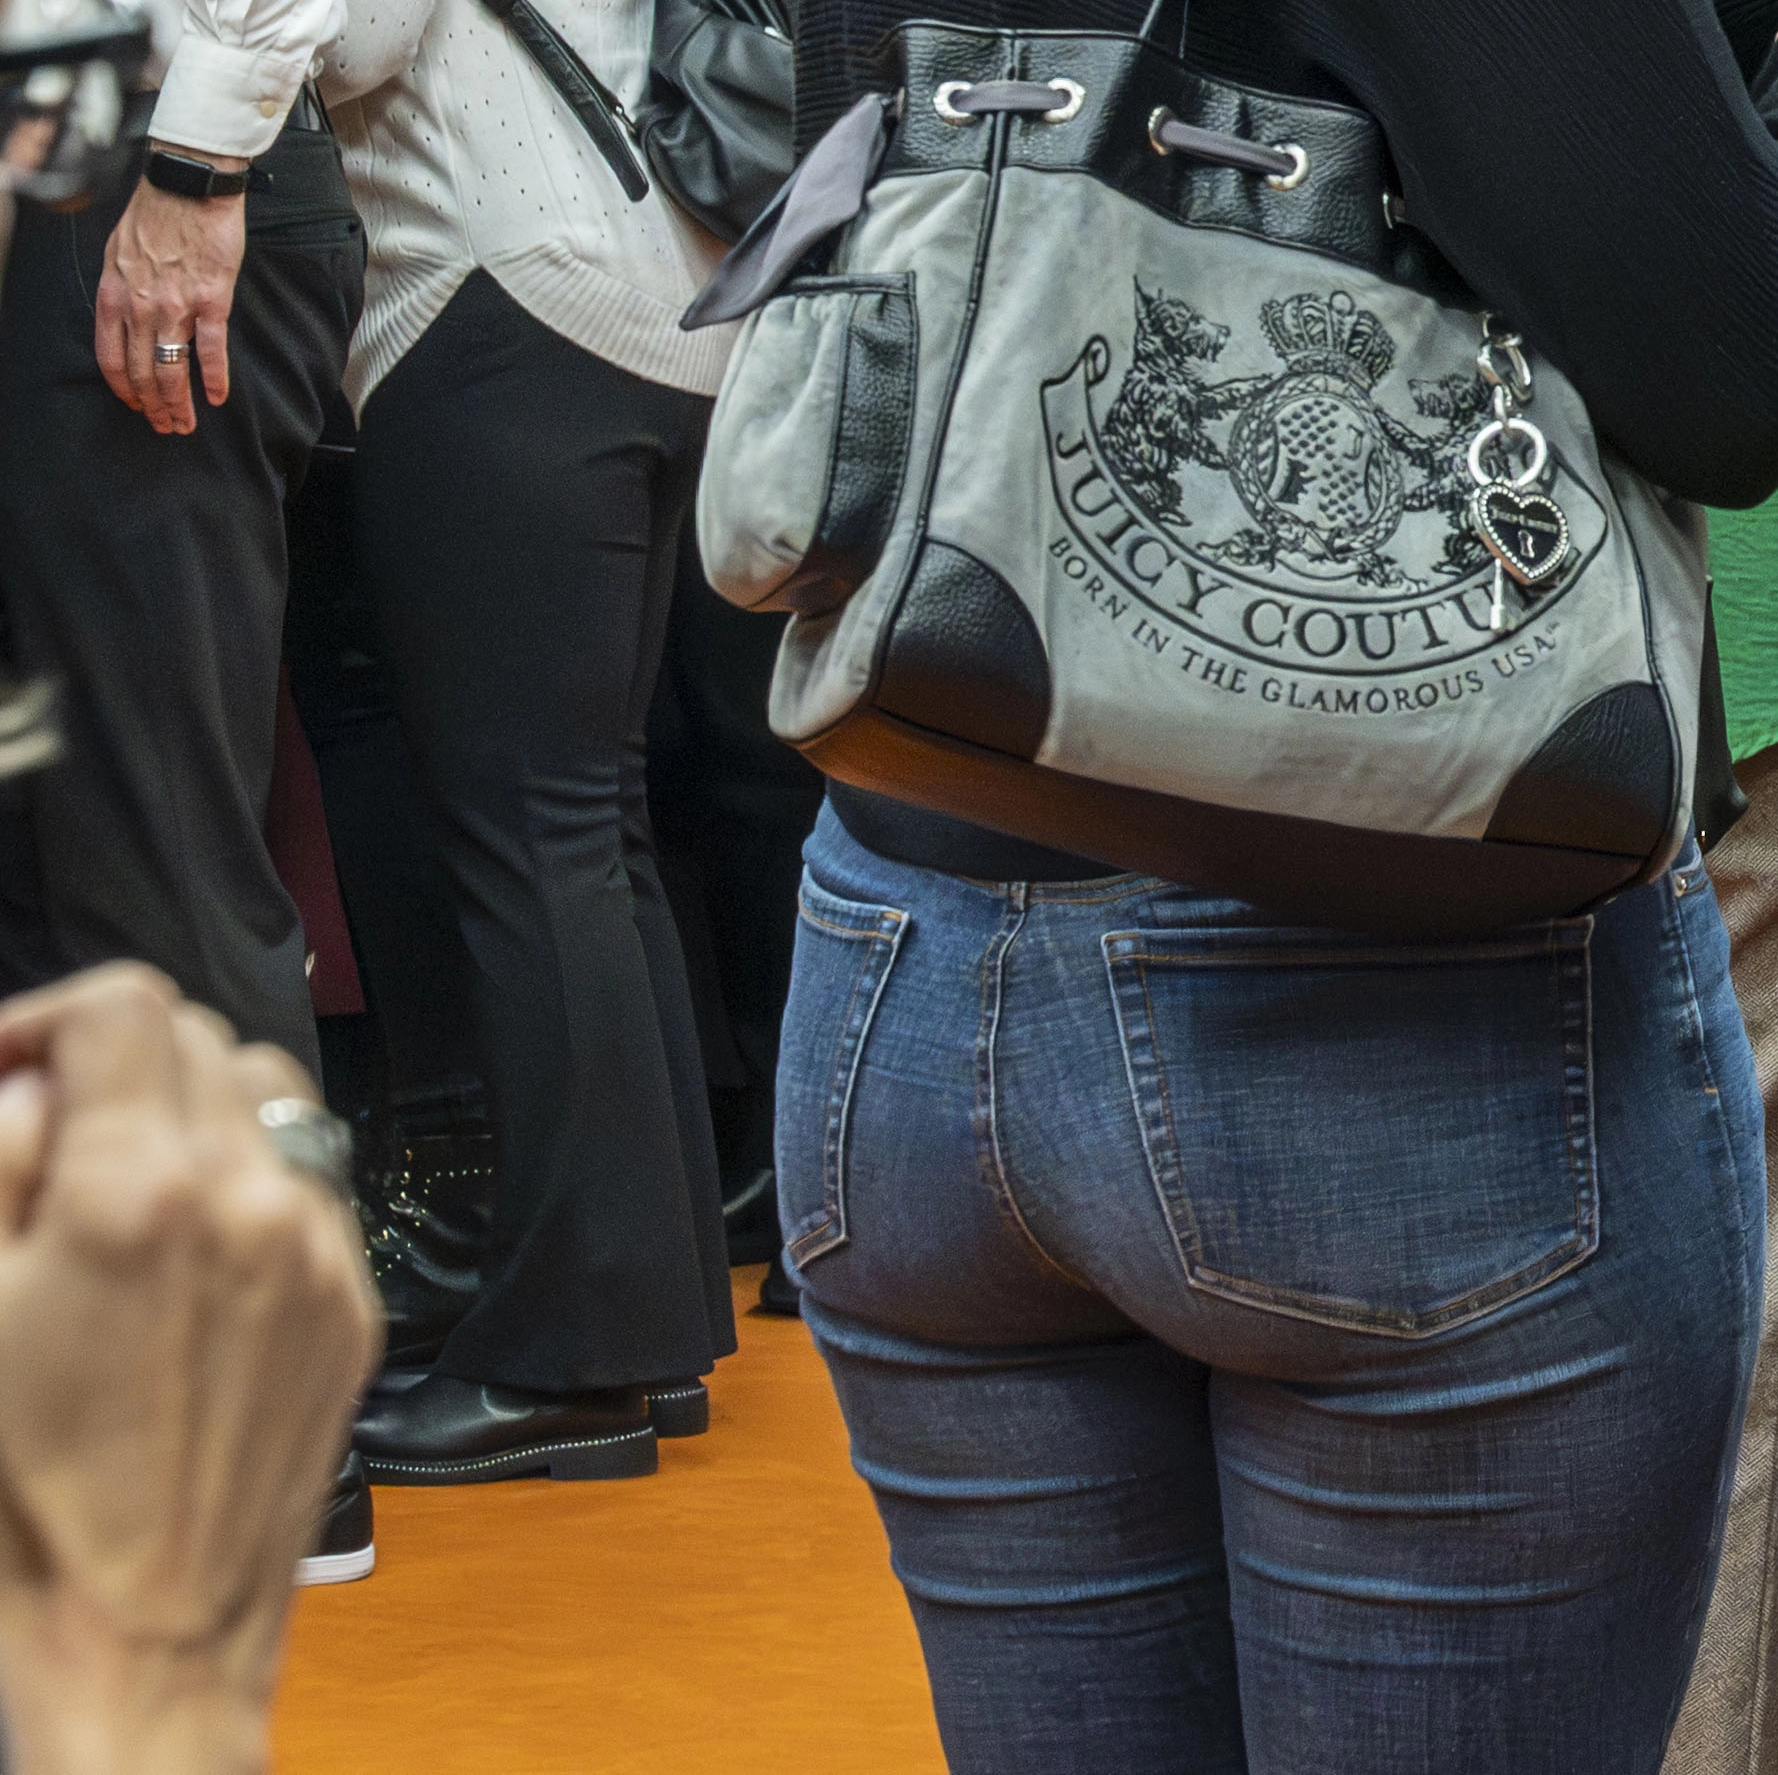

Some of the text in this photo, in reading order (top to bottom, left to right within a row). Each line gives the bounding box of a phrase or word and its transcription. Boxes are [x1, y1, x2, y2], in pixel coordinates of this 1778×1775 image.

[1055, 429, 1232, 619] JUICY
[1048, 536, 1134, 622] BORN
[1132, 621, 1170, 654] IN
[1181, 646, 1249, 694] THE
[1261, 669, 1485, 716] GLAMOROUS
